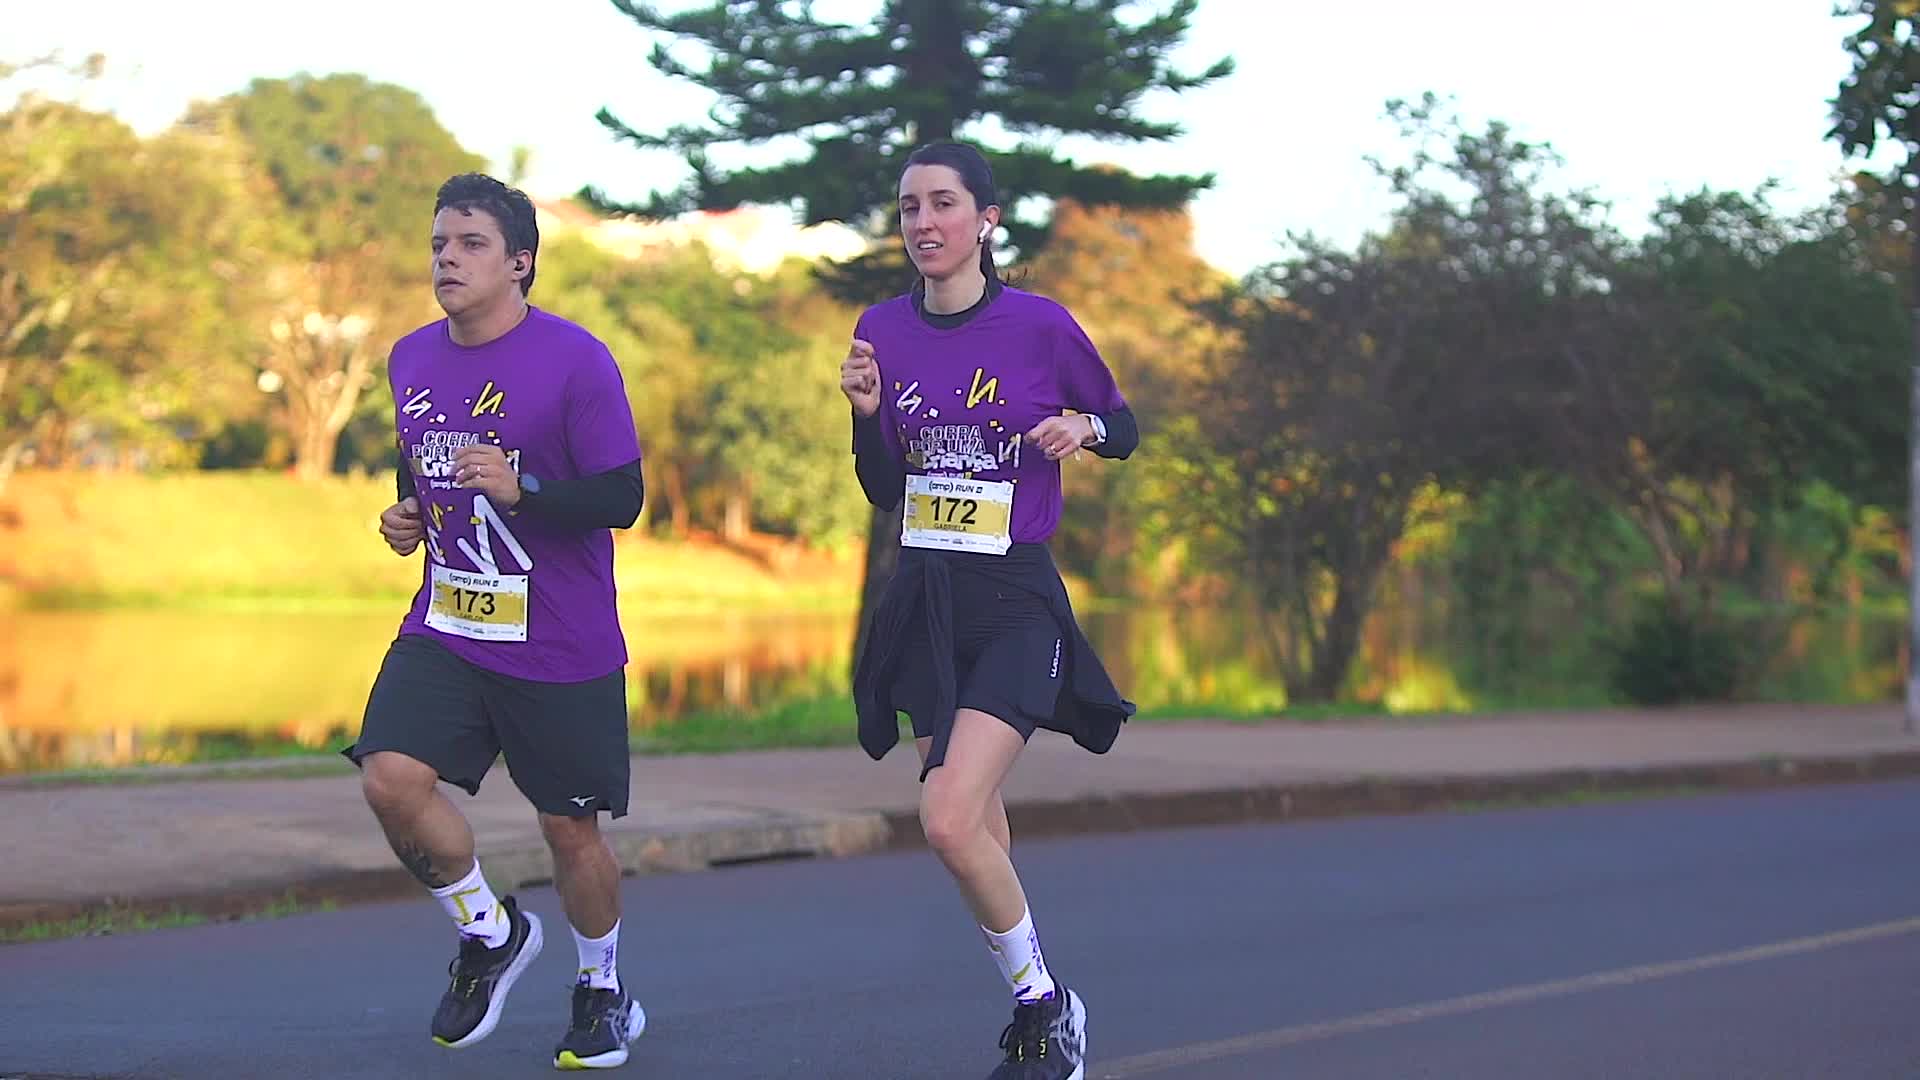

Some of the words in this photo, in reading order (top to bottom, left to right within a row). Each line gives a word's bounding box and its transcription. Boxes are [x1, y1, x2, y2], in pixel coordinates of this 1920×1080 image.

[920, 425, 982, 441] CORRA
[411, 444, 446, 461] POR
[909, 440, 945, 455] POR
[946, 438, 986, 455] UMA
[955, 483, 974, 493] RUN
[930, 496, 978, 525] 172
[472, 578, 491, 587] RUN
[452, 587, 496, 615] 173
